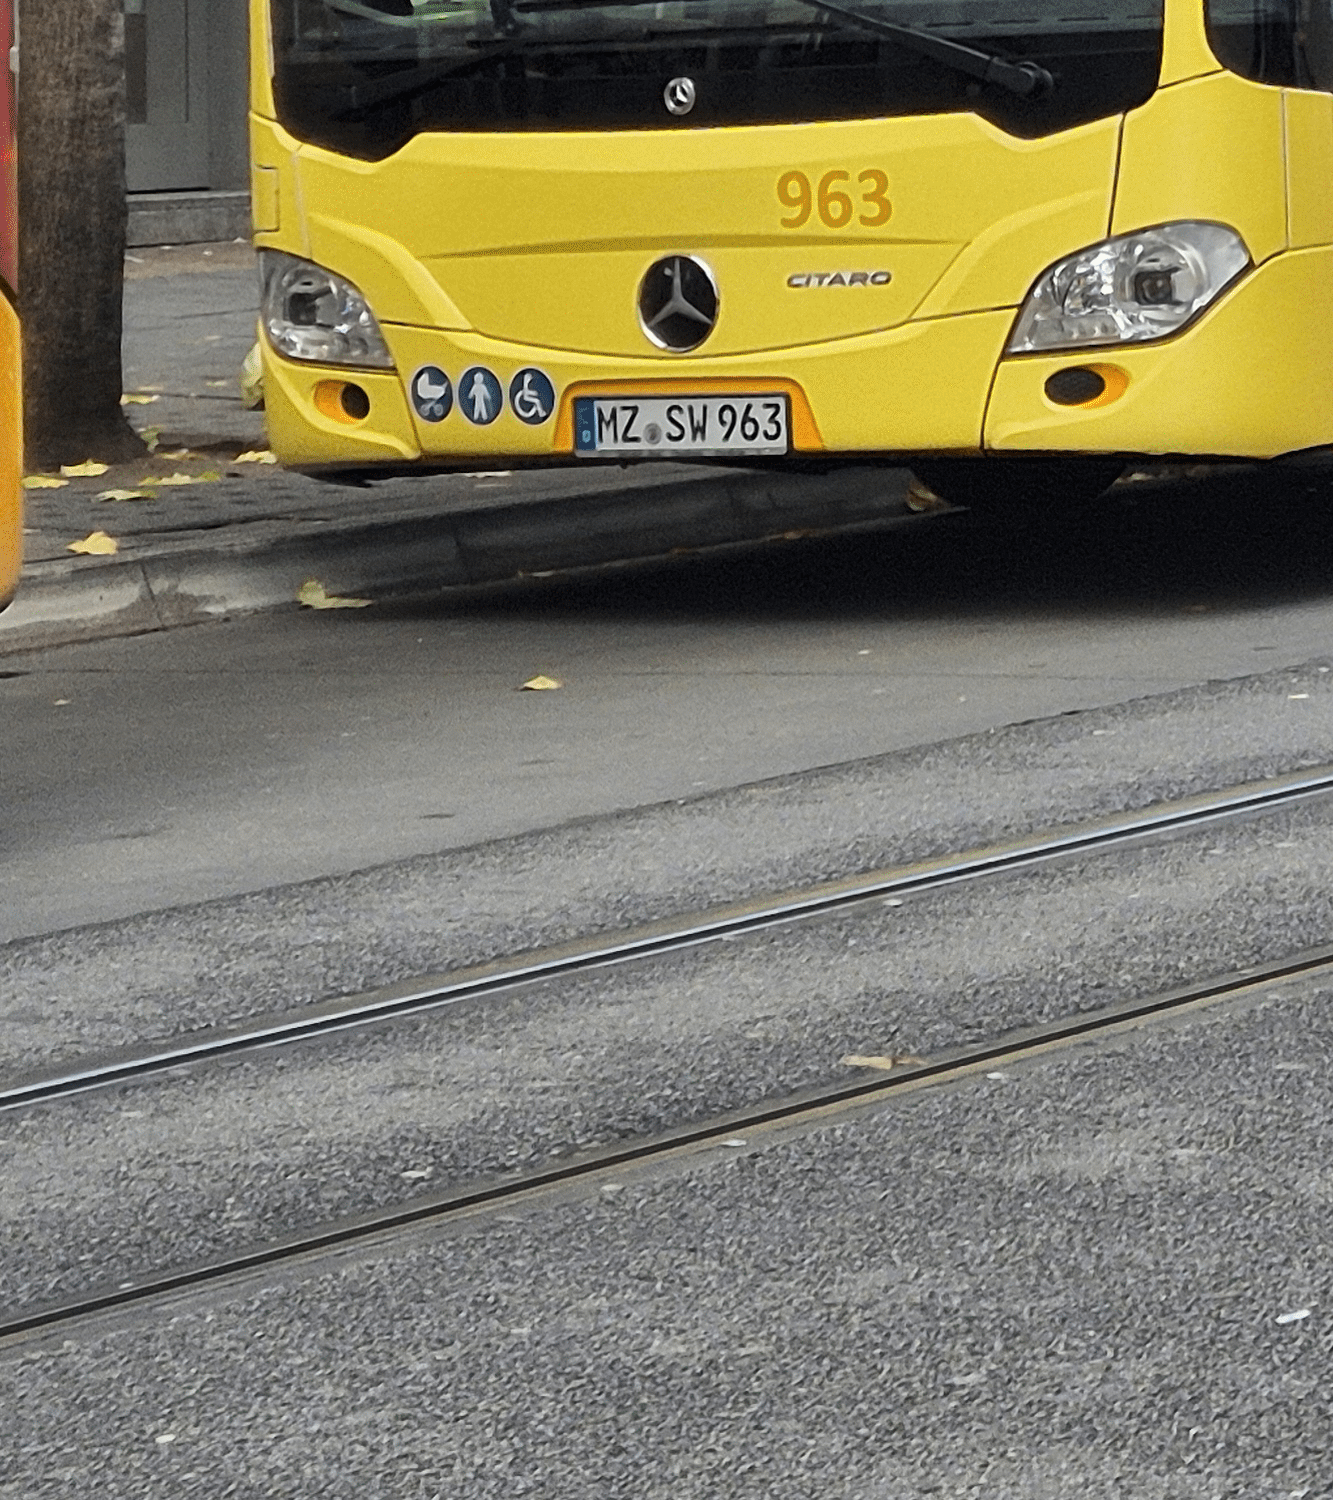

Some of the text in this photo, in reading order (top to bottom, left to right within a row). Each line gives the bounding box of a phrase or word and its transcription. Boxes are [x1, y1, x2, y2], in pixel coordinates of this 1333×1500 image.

[776, 168, 893, 229] 963
[786, 270, 893, 289] CITARO
[596, 403, 783, 444] MZ SW 963
